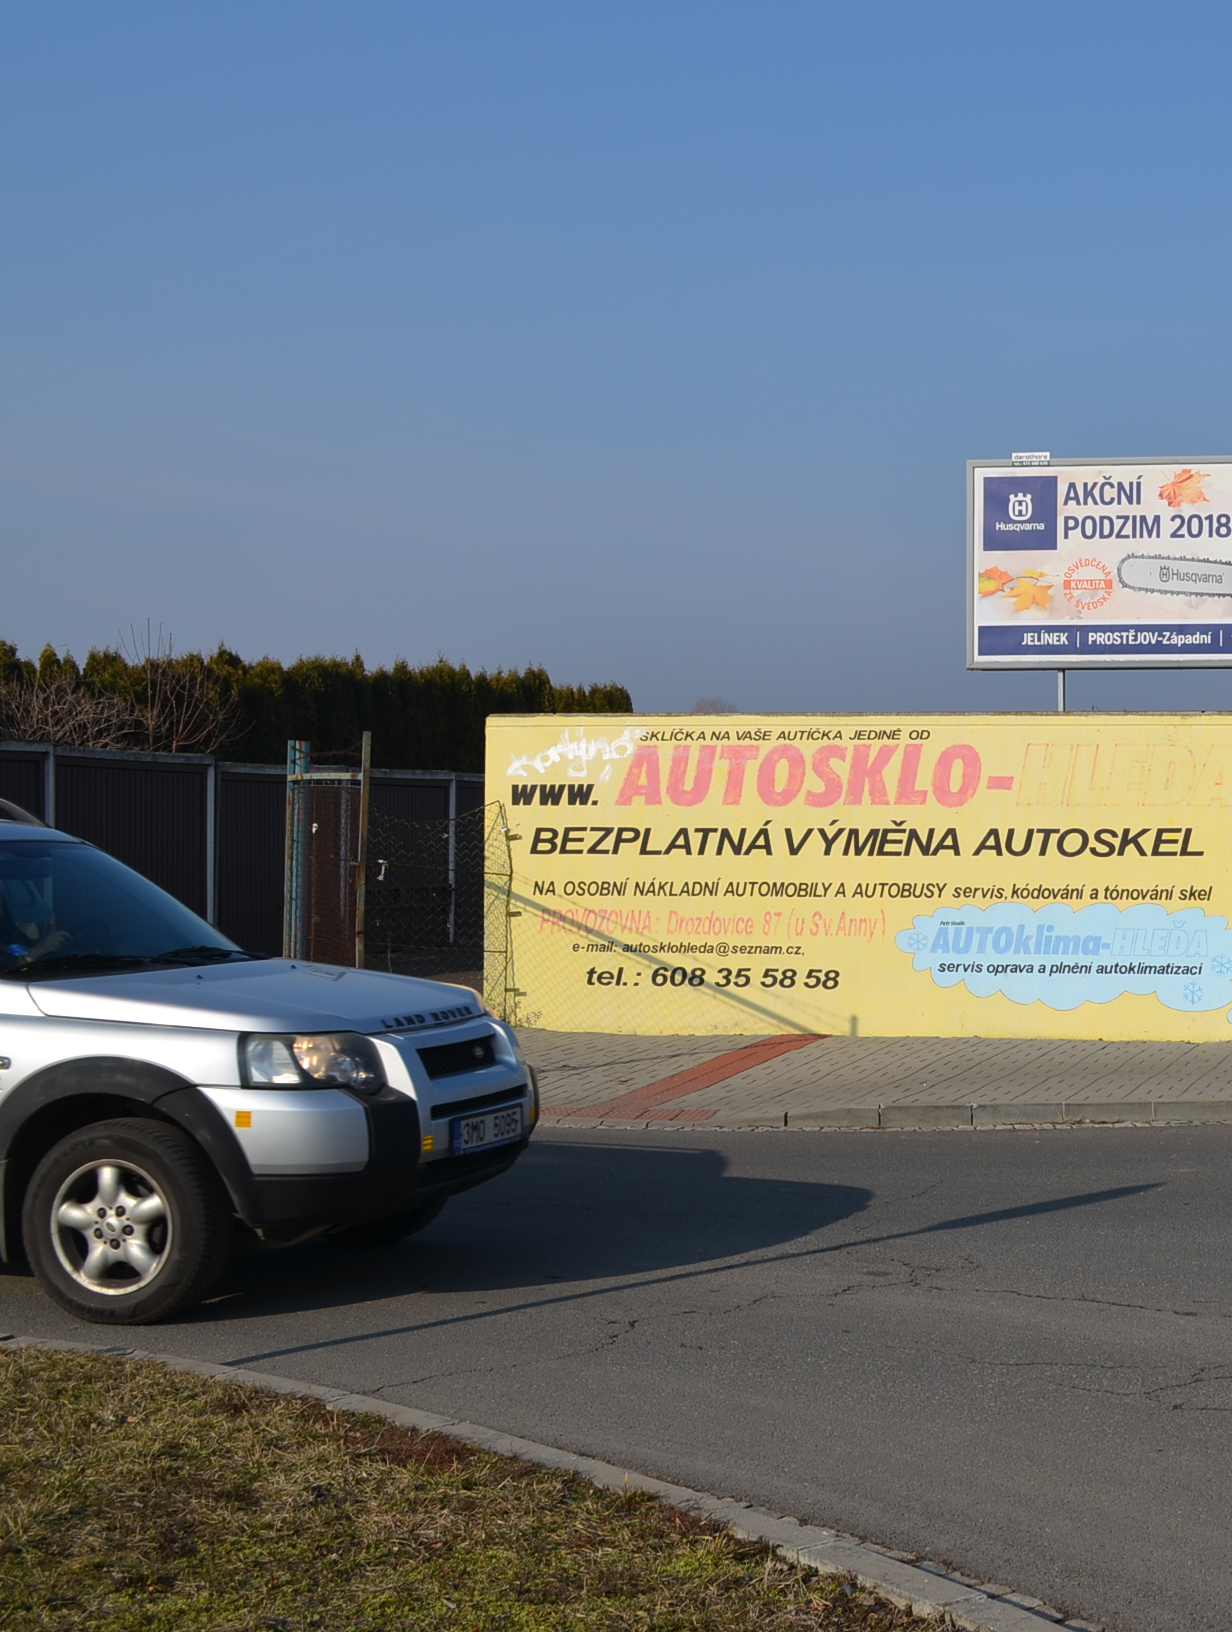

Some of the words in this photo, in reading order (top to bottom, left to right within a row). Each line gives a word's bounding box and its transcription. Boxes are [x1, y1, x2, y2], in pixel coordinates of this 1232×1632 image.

[1062, 474, 1144, 506] AKČNÍ
[996, 521, 1045, 532] Husqvarna
[1063, 514, 1161, 540] PODZIM
[1169, 513, 1232, 538] 2018
[1064, 557, 1114, 579] OSVĚDČENÁ
[1171, 569, 1224, 584] Husqvarna
[1064, 590, 1076, 602] ZE
[1070, 580, 1106, 590] KVALITA
[1022, 631, 1068, 646] JELÍNEK
[1088, 630, 1212, 647] PROSTĚJOV-Západní
[640, 728, 706, 742] SKLÍČKA
[710, 730, 730, 742] NA
[736, 728, 772, 741] VAŠE
[776, 728, 843, 741] AUTÍČKA
[848, 728, 902, 741] JEDINĚ
[909, 730, 930, 741] OD
[530, 820, 773, 856] BEZPLATNÁ
[785, 820, 961, 857] VÝMĚNA
[973, 828, 1206, 858] AUTOSKEL
[533, 880, 556, 896] NA
[562, 877, 630, 898] OSOBNÍ
[633, 878, 722, 898] NÁKLADNÍ
[723, 880, 832, 898] AUTOMOBILY
[834, 882, 846, 898] A
[852, 882, 948, 900] AUTOBUSY
[952, 884, 1008, 901] servis,
[1011, 883, 1084, 900] kódování
[1088, 887, 1100, 900] a
[1102, 883, 1174, 901] tónování
[1178, 884, 1213, 902] skel
[762, 912, 782, 936] 87
[572, 940, 618, 954] e-mail:
[622, 941, 806, 958] autosklohleda@seznam.cz,
[586, 966, 642, 987] tel.:
[650, 966, 706, 988] 608
[714, 967, 752, 988] 35
[760, 968, 797, 989] 58
[802, 968, 841, 990] 58
[938, 961, 984, 974] servis
[986, 963, 1034, 976] oprava
[1038, 964, 1046, 974] a
[1048, 960, 1092, 977] plnění
[1096, 961, 1204, 976] autoklimatizací
[380, 1014, 426, 1029] LAND
[430, 1006, 474, 1022] ROVER
[494, 1110, 518, 1138] 5095
